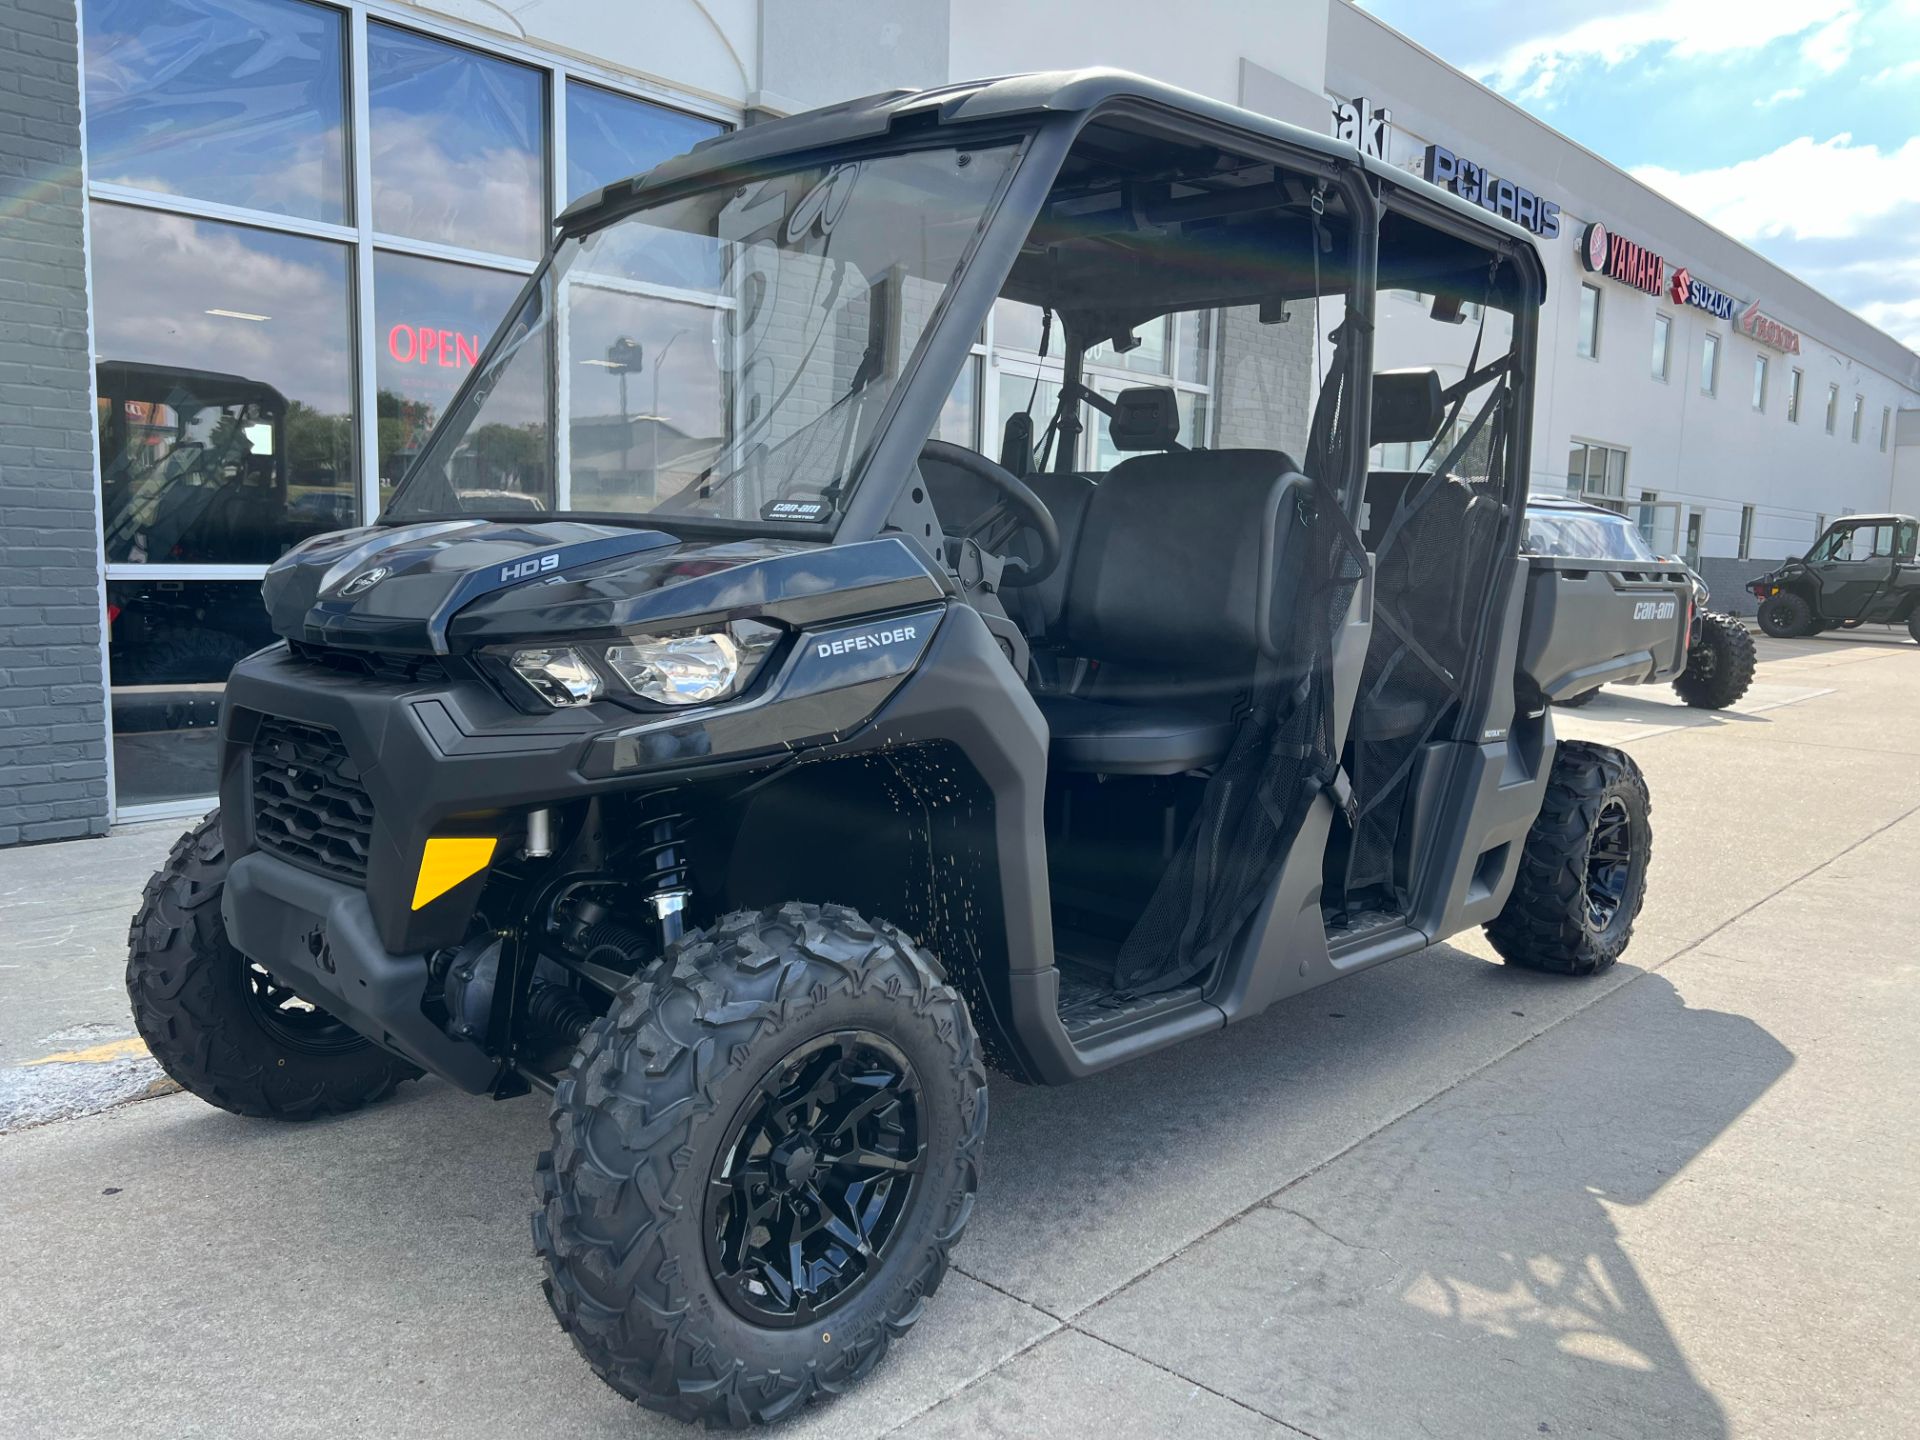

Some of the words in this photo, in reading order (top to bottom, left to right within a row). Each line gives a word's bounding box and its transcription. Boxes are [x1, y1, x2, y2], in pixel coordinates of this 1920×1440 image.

[1427, 144, 1560, 239] POLARIS
[1607, 232, 1664, 296] YAMAHA
[1691, 280, 1735, 321] SUZUKI
[388, 324, 478, 369] OPEN
[1755, 314, 1800, 353] HONDA
[501, 553, 559, 582] HD9
[818, 626, 916, 658] DEFENDER
